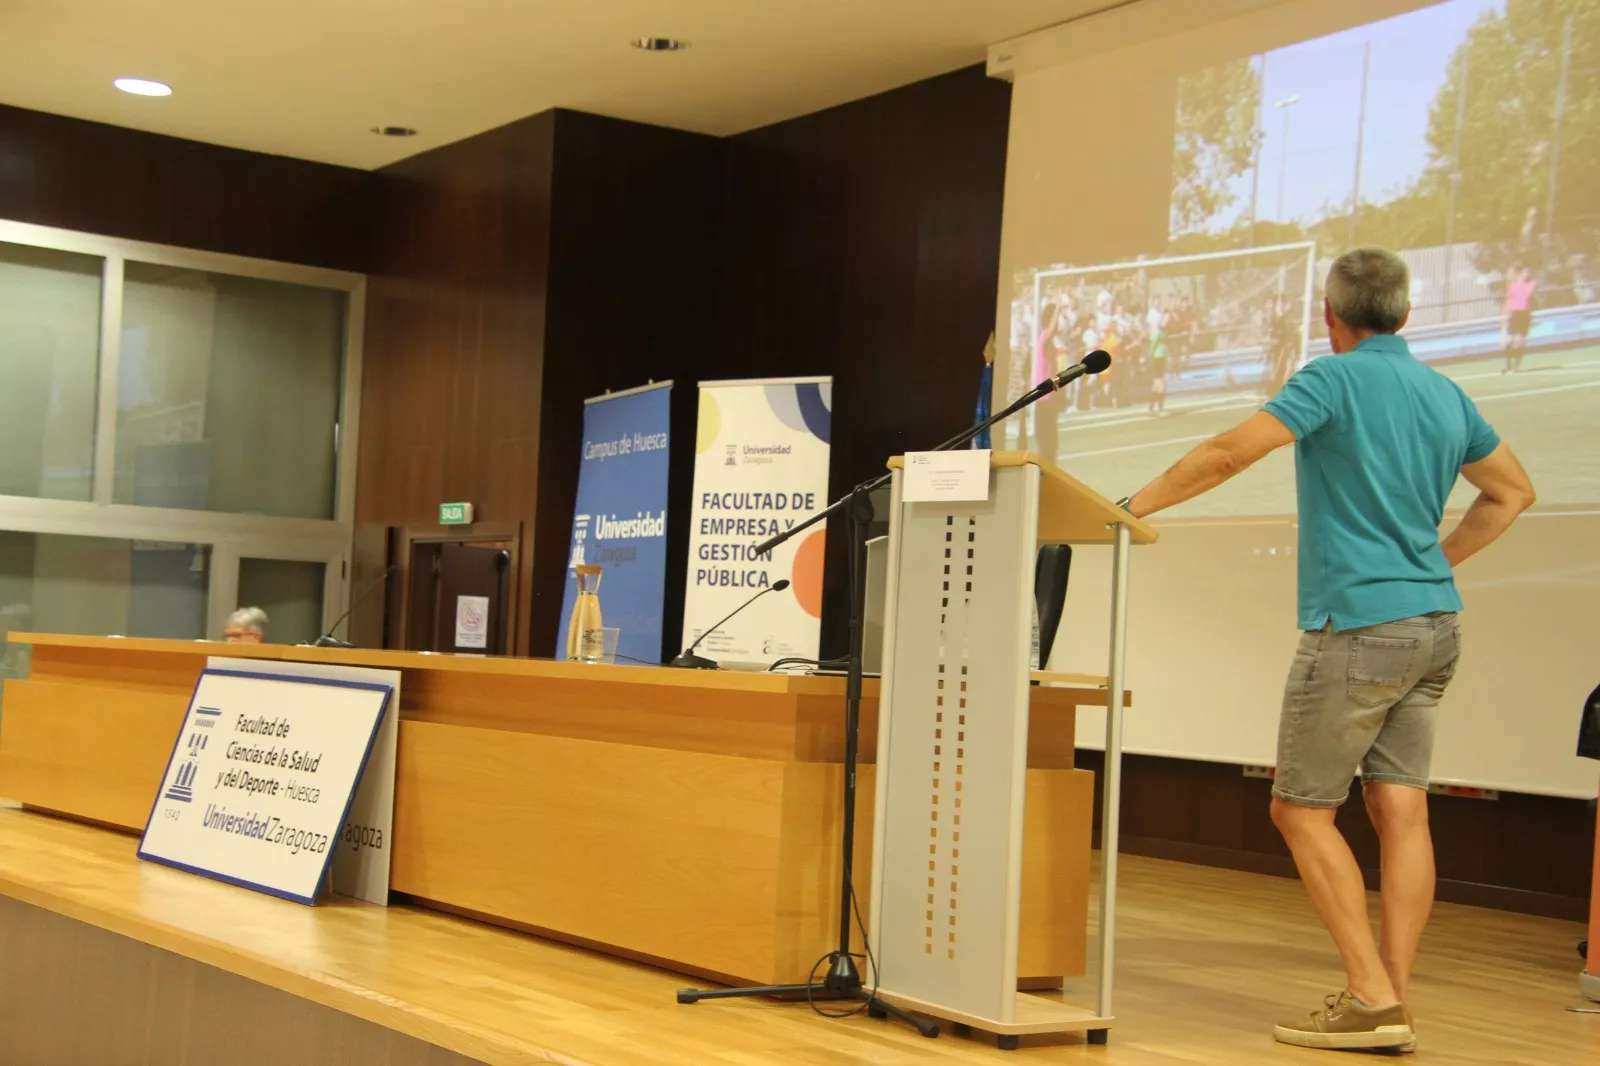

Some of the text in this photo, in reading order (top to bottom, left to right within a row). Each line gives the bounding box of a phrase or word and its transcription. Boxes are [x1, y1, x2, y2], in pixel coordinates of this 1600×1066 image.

[583, 431, 668, 462] Campus de Huesca
[742, 444, 791, 455] Universidad
[702, 493, 815, 511] FACULTAD DE
[595, 510, 665, 540] Universidad
[699, 518, 780, 536] EMPRESA
[698, 540, 773, 562] GESTIÓN
[696, 565, 770, 588] PÚBLICA
[235, 713, 291, 739] Facultad de
[226, 740, 322, 774] Ciencias de la Salud
[214, 771, 224, 790] y
[223, 769, 240, 789] del
[238, 771, 280, 798] Deporte
[284, 778, 320, 804] Huesca
[203, 803, 328, 855] Universidad Zaragoza
